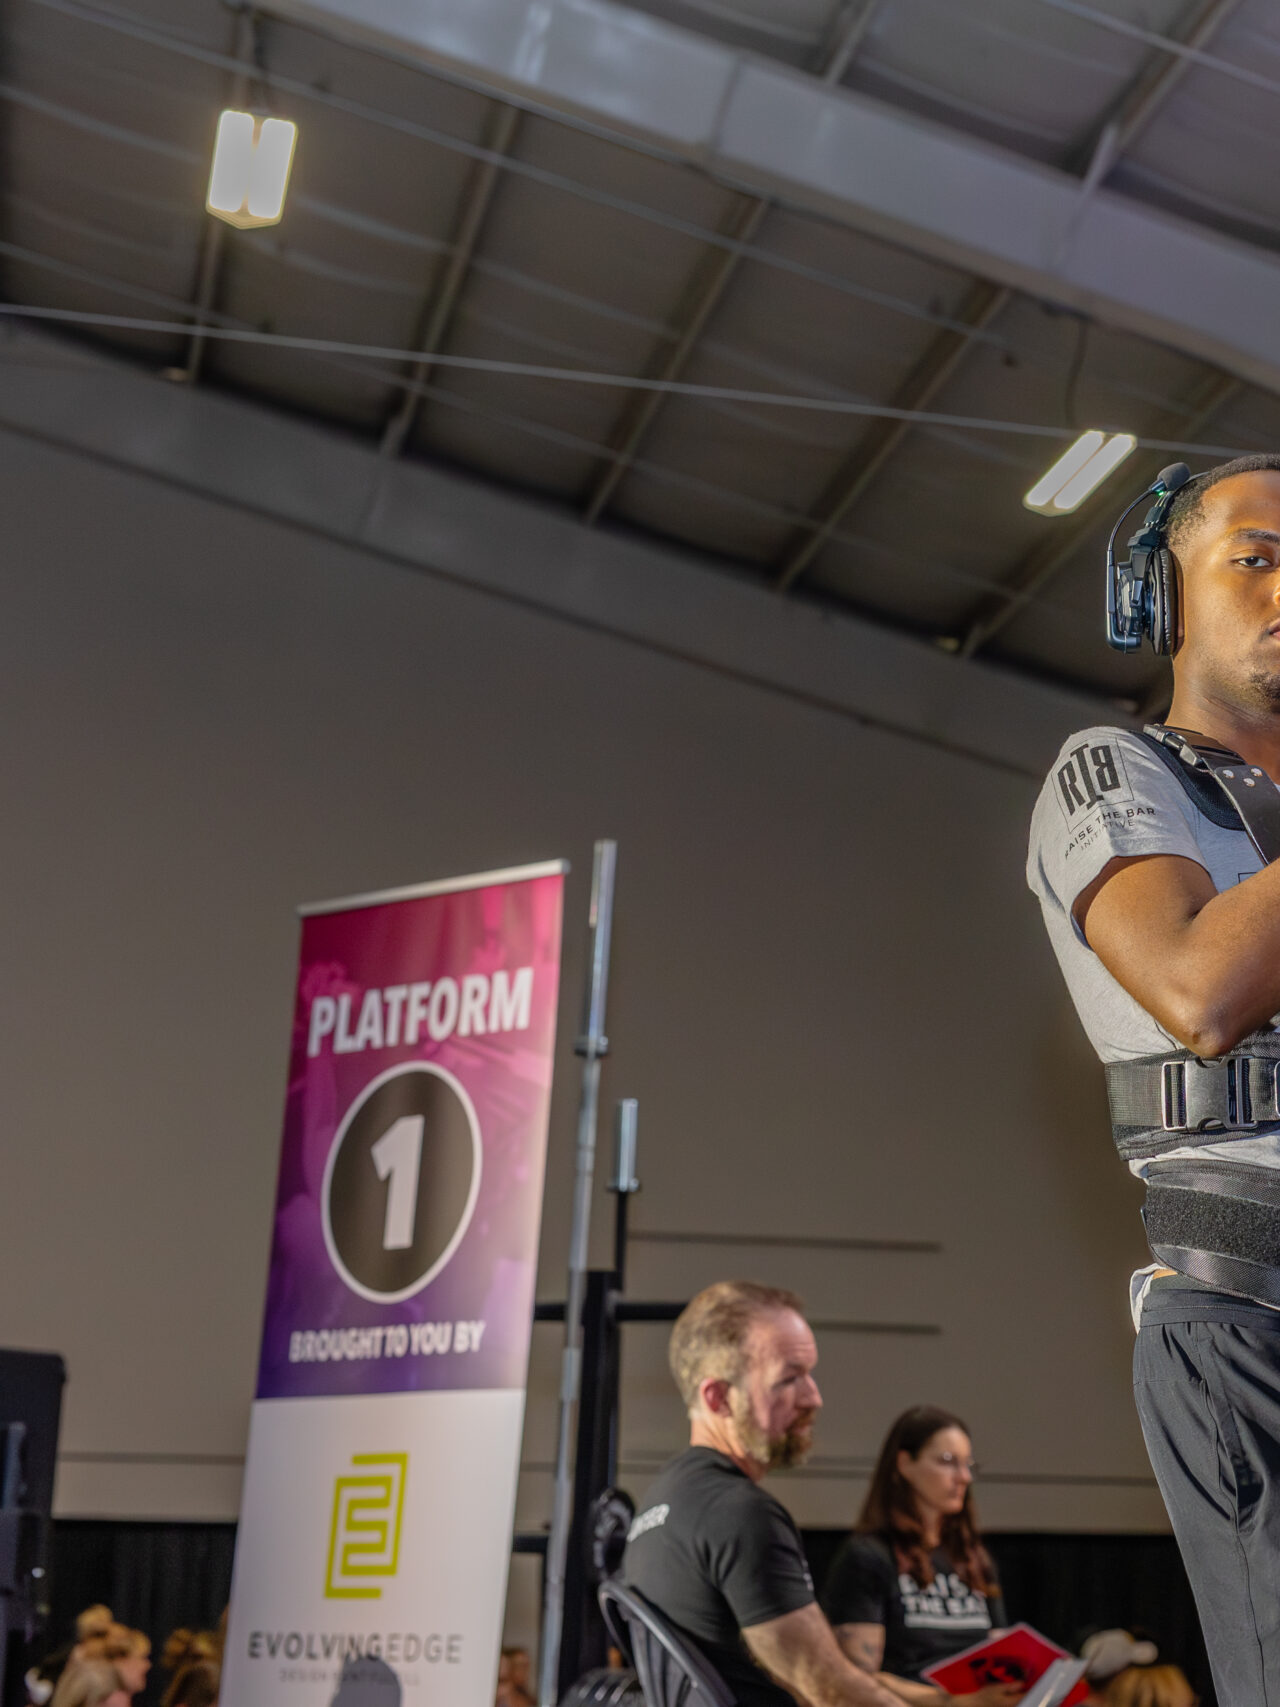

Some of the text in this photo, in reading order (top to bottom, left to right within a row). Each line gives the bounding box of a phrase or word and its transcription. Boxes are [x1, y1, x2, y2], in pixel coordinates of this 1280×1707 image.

[1095, 811, 1121, 825] THE
[1126, 807, 1156, 818] BAR
[307, 967, 533, 1058] PLATFORM
[370, 1115, 425, 1251] 1
[288, 1320, 487, 1364] BROUGHT TO YOU BY
